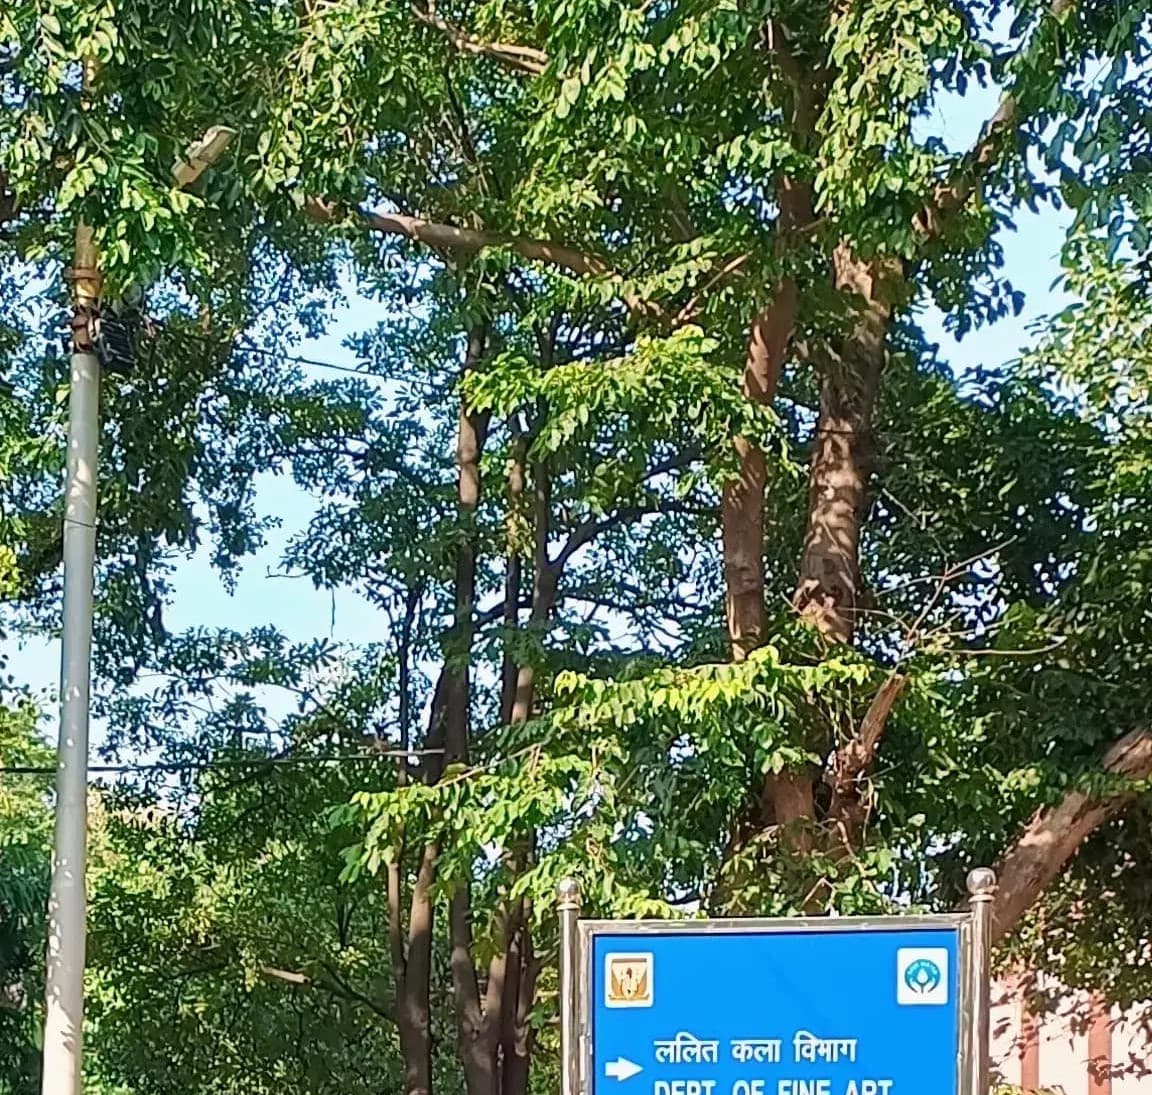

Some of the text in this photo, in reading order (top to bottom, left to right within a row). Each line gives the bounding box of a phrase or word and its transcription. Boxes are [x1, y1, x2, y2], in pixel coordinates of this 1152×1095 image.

[654, 1030, 857, 1063] ललित कला विभाग
